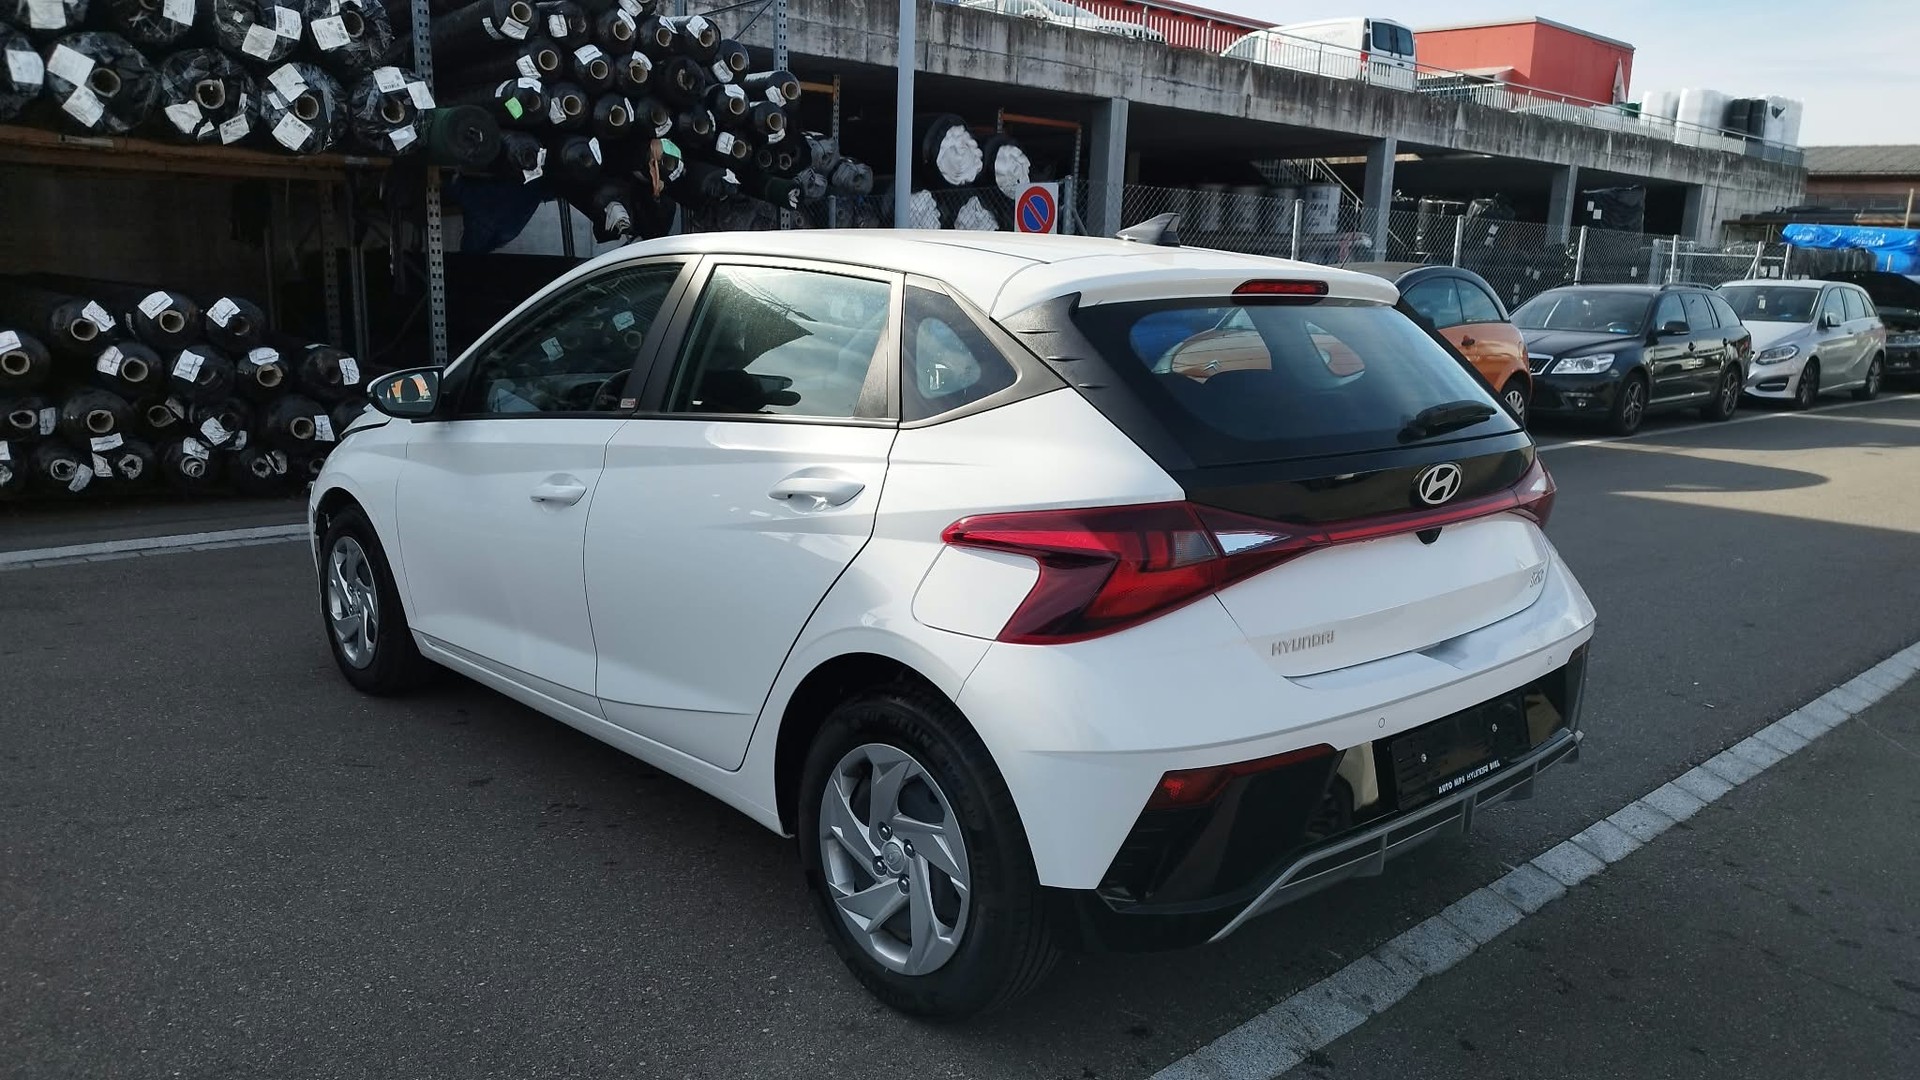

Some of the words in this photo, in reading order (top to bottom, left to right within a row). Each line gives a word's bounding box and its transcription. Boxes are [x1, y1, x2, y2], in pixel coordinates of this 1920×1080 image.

[1271, 629, 1335, 656] HYUNDAI
[1439, 780, 1453, 795] AUTO
[1466, 764, 1489, 781] HYUNDAI
